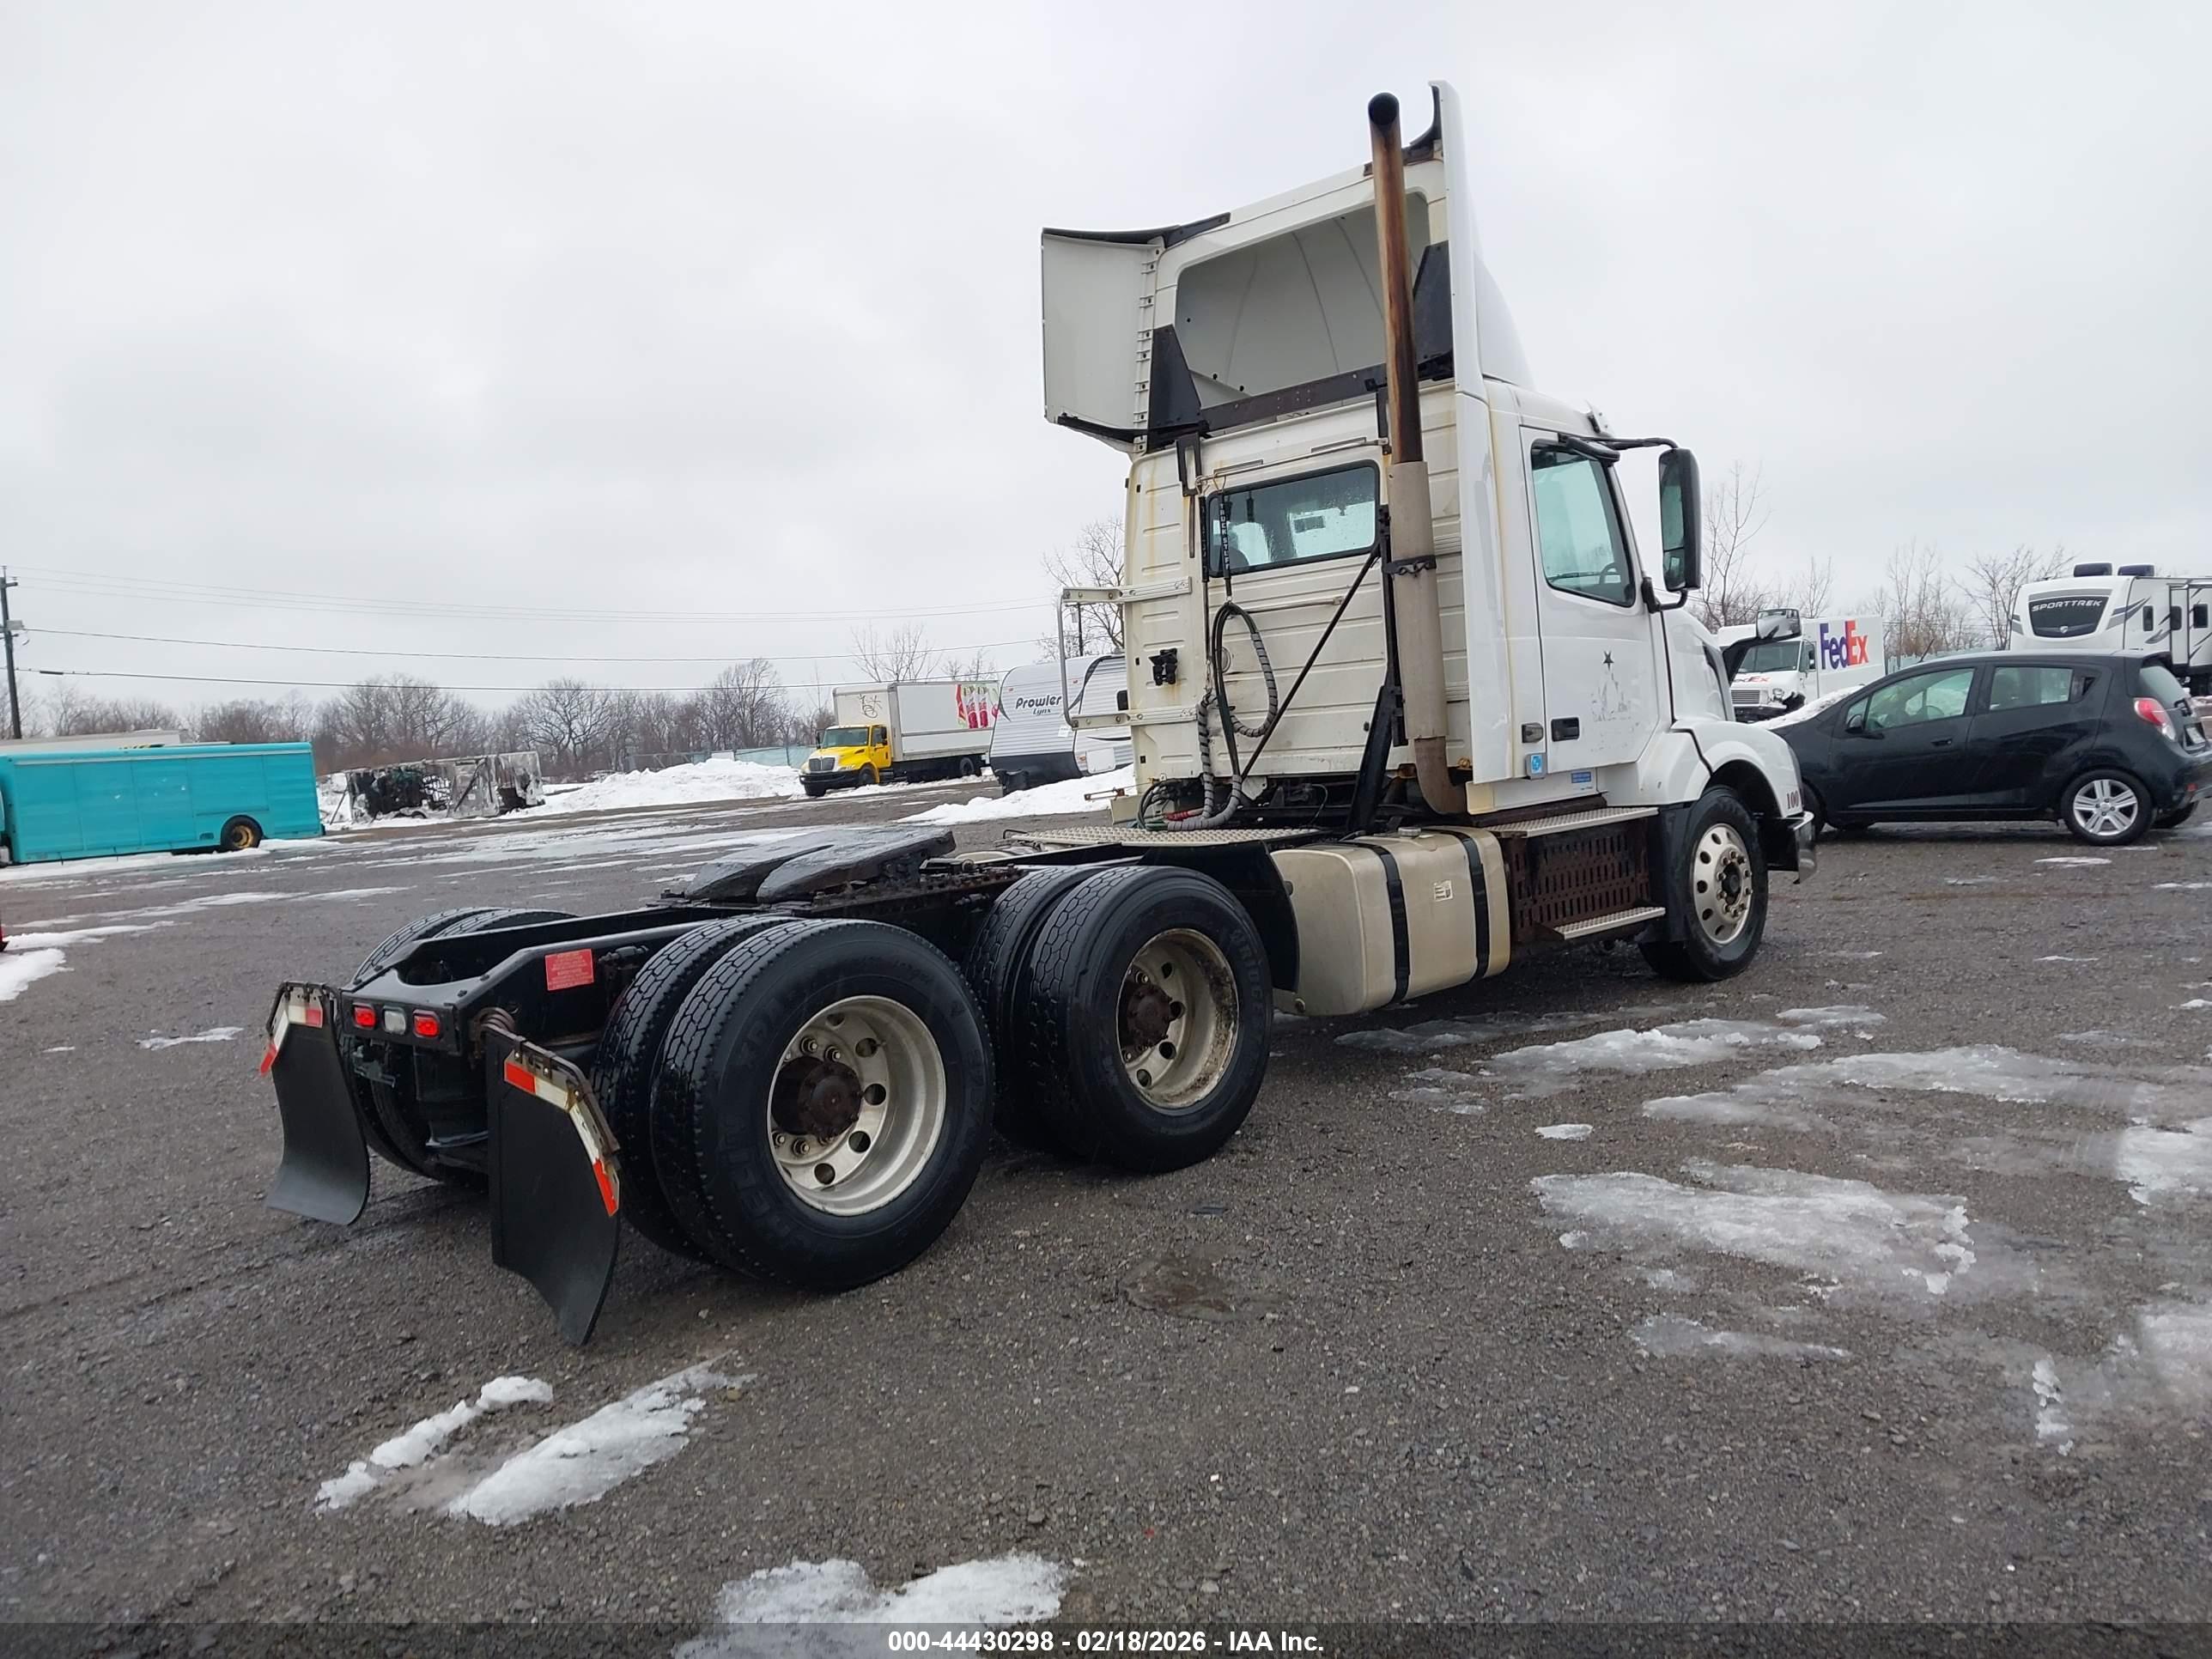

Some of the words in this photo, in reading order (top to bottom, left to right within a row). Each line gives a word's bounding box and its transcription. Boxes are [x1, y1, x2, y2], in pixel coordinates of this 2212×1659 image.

[2032, 599, 2102, 612] SPORTTREK
[1820, 620, 1869, 670] FedEx
[1016, 695, 1062, 709] Prowler
[1787, 790, 1799, 809] 100
